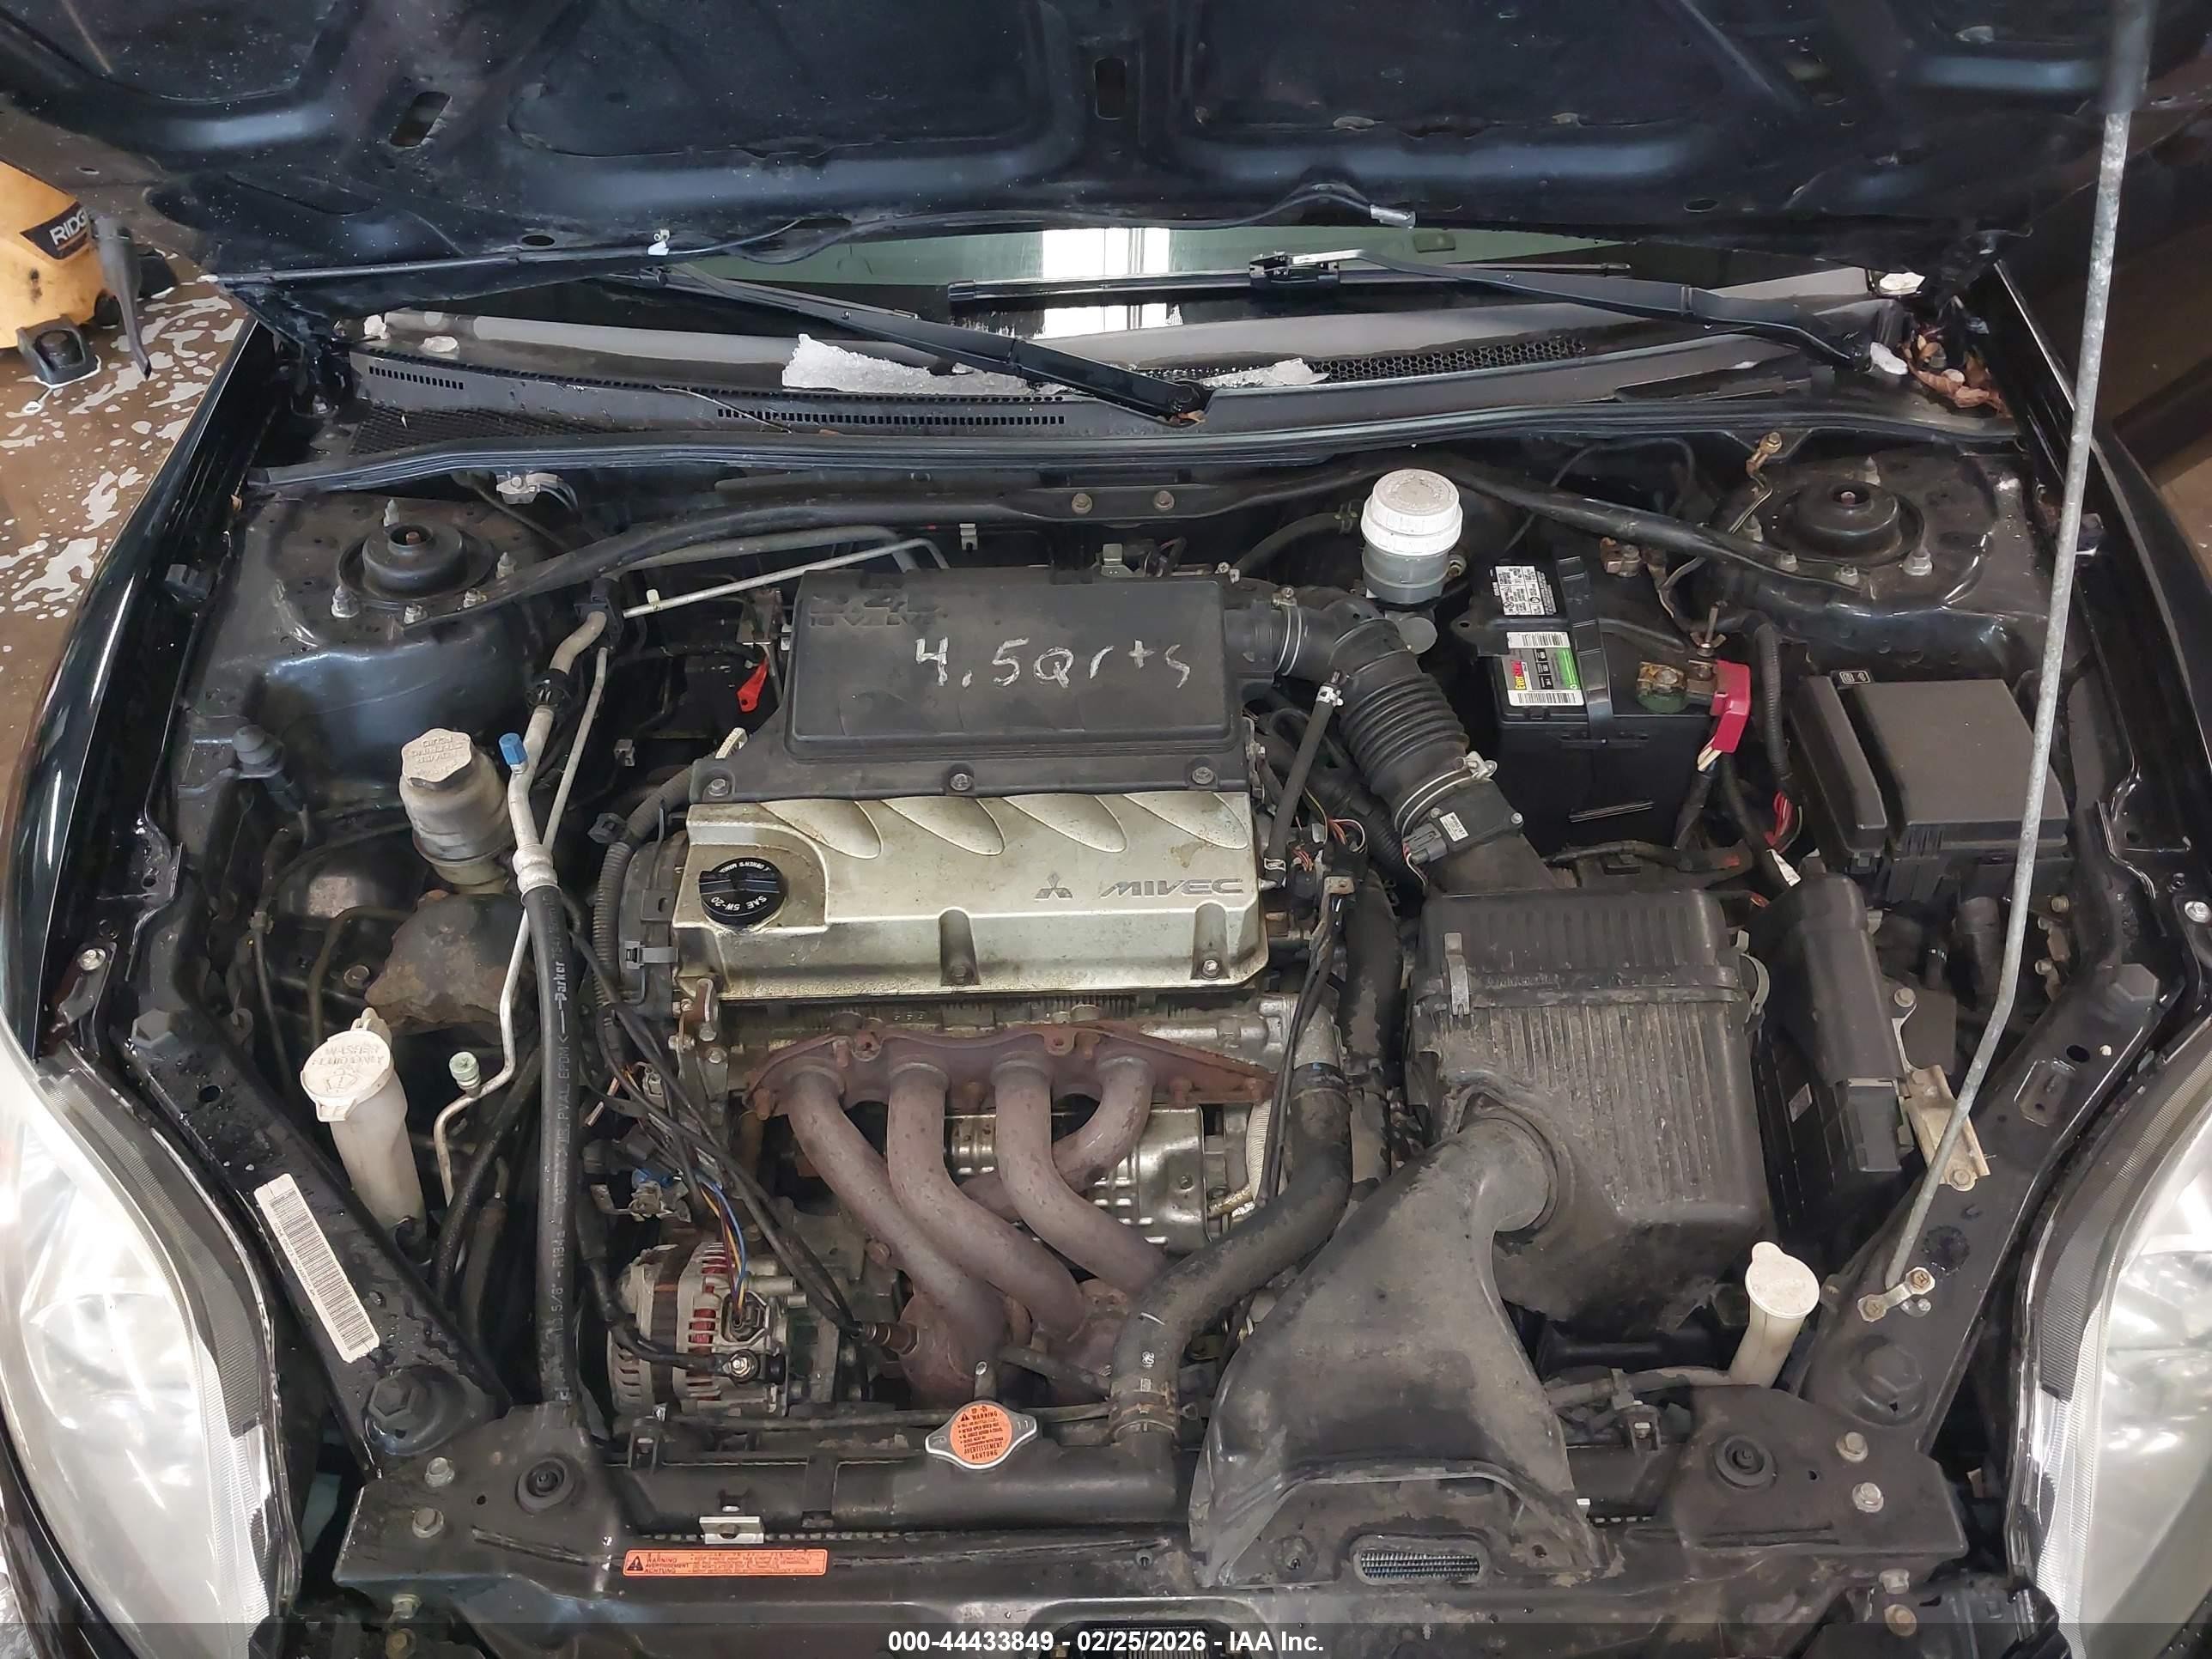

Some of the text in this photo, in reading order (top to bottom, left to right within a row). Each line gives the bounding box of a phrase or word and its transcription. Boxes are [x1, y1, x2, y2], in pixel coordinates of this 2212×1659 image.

[49, 207, 88, 246] RIDG
[1100, 878, 1244, 899] MIVEC
[710, 895, 768, 911] SAE 5W-20
[552, 961, 568, 1002] Parker
[971, 1411, 998, 1420] WARNING
[963, 1442, 1003, 1455] AVERTISSEMENT
[971, 1450, 998, 1460] ACHTUNG
